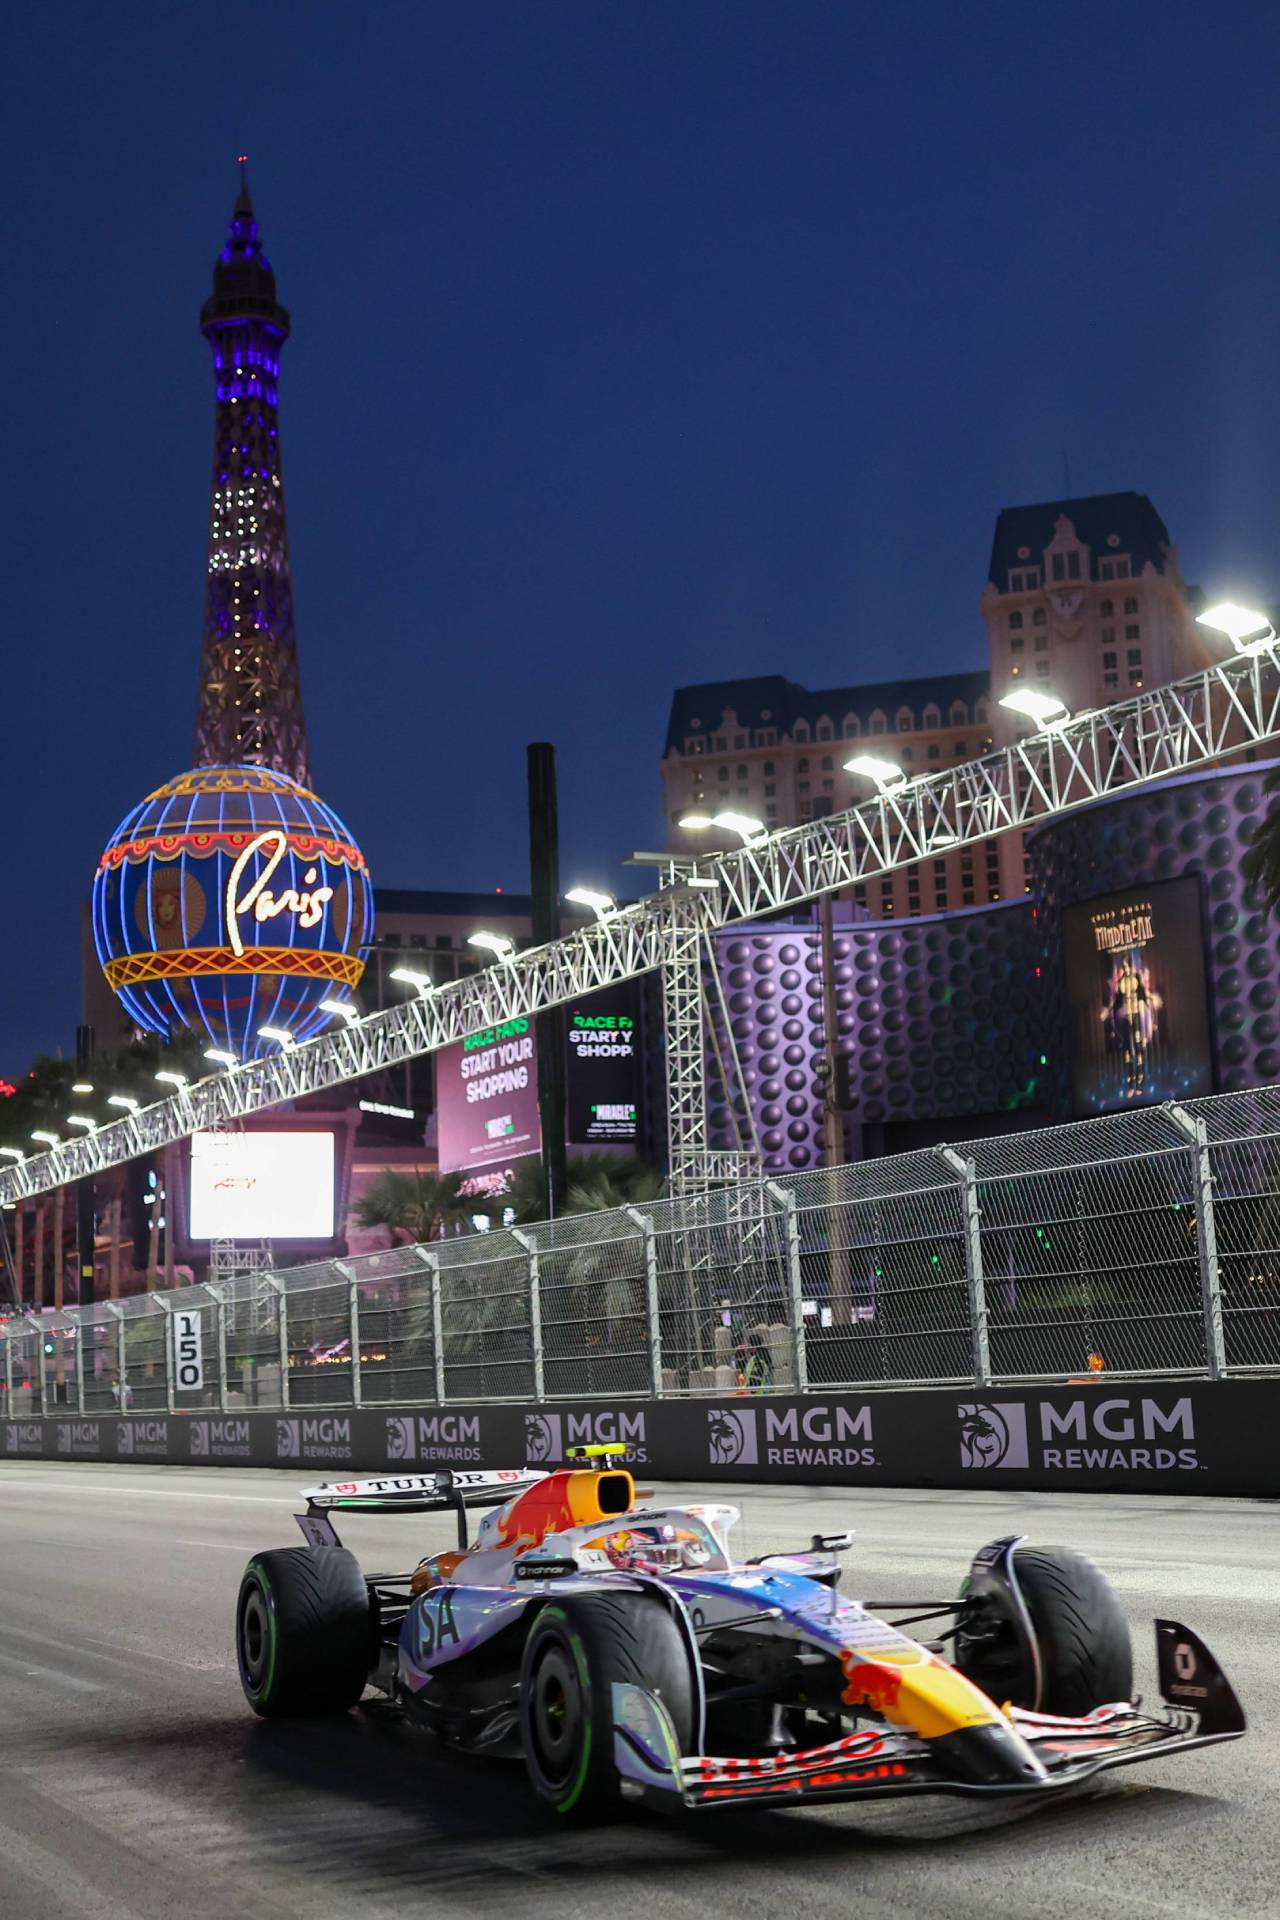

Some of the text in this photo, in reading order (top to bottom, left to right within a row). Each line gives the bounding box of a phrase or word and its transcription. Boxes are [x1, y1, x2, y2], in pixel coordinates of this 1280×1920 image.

[226, 830, 333, 957] Paris
[574, 1016, 616, 1028] RACE
[569, 1030, 619, 1043] START
[460, 1037, 533, 1079] START YOUR
[466, 1066, 529, 1104] SHOPPING
[180, 1316, 199, 1386] 150
[302, 1418, 350, 1442] MGM
[419, 1416, 480, 1442] MGM
[567, 1412, 646, 1442] MGM
[765, 1406, 873, 1442] MGM
[1039, 1397, 1195, 1441] MGM
[71, 1424, 99, 1441] MGM
[135, 1422, 168, 1442] MGM
[210, 1421, 250, 1442] MGM
[303, 1446, 352, 1458] REWARDS
[420, 1447, 481, 1461] REWARDS
[768, 1448, 876, 1466] REWARDS
[1043, 1448, 1199, 1470] REWARDS
